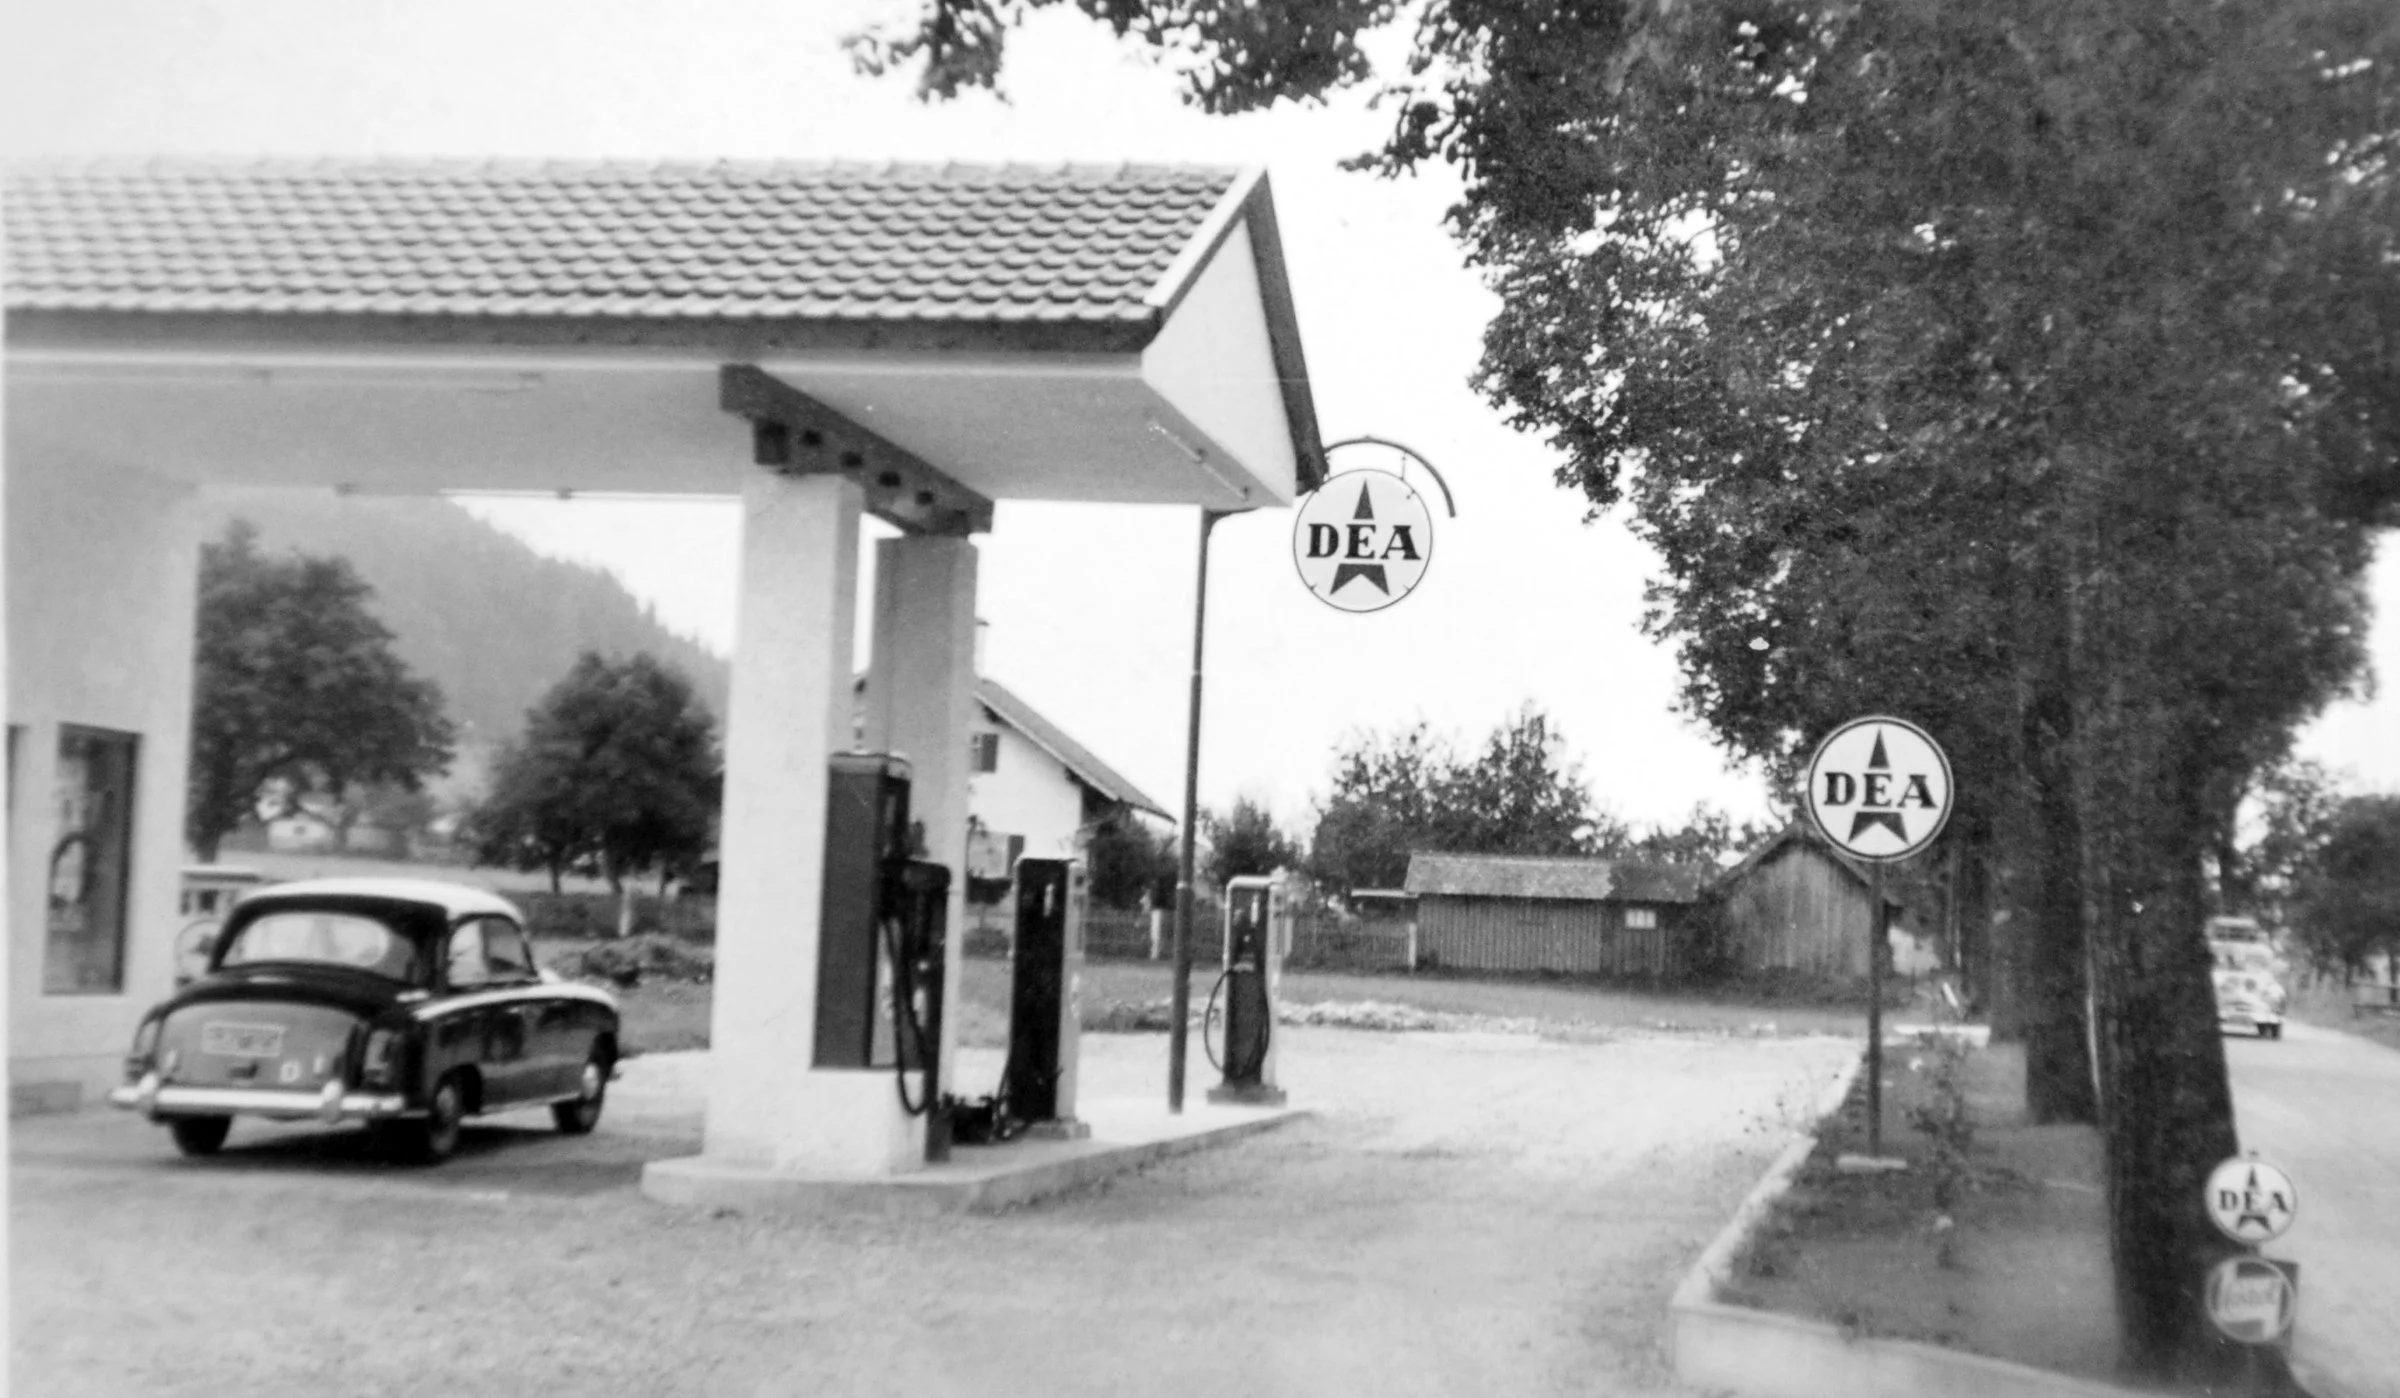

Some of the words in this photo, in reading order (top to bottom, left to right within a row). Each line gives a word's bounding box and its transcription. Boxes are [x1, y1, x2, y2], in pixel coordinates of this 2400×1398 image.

[1306, 523, 1422, 560] DEA
[1823, 772, 1937, 809] DEA
[2218, 1189, 2288, 1213] DEA
